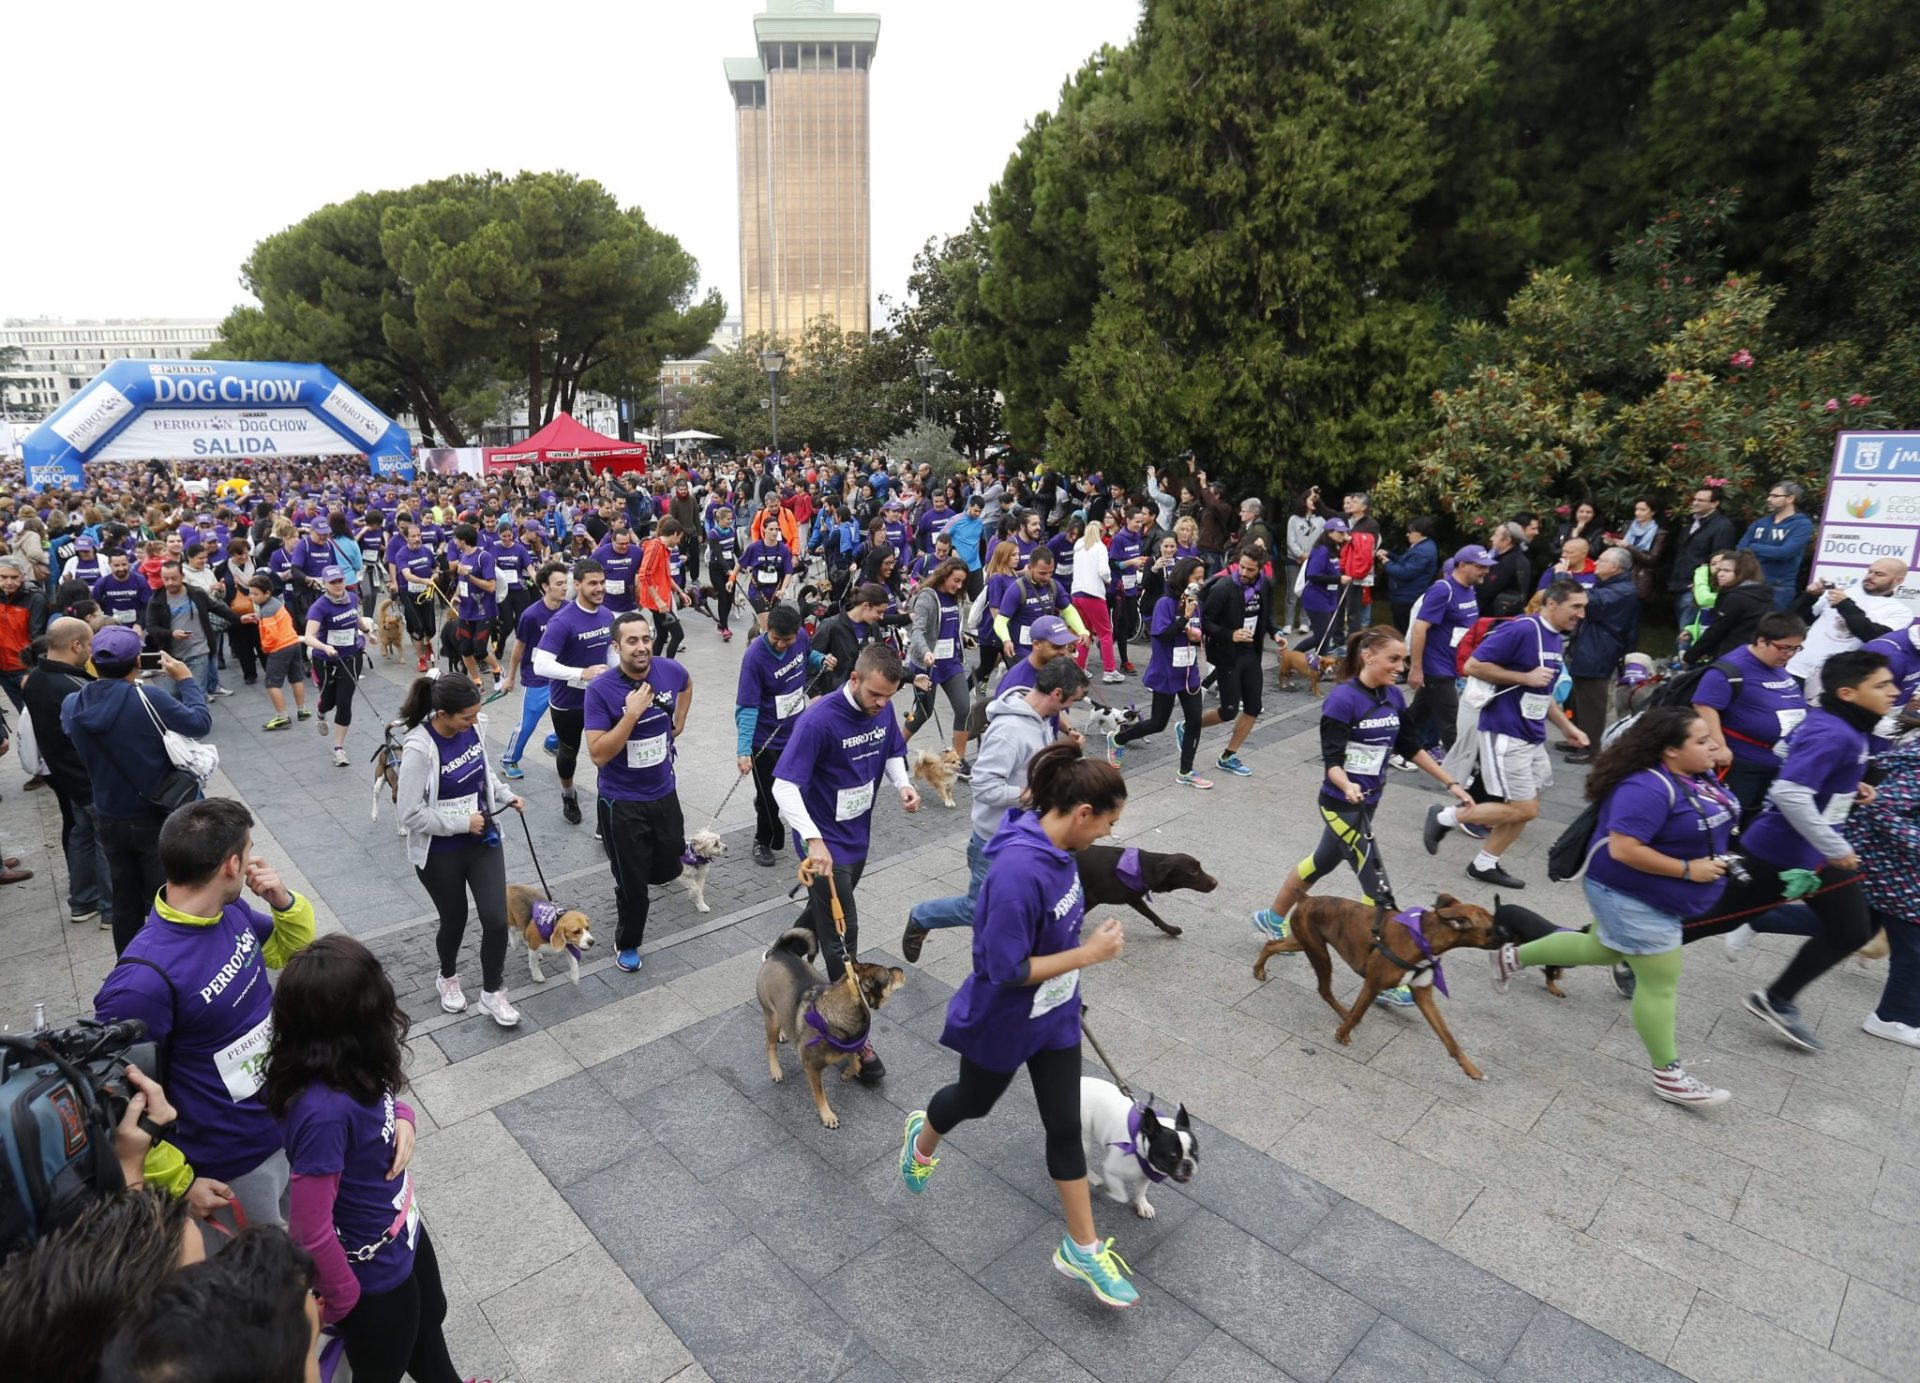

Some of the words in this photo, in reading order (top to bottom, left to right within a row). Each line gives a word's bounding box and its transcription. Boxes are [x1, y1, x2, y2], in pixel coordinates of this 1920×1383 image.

[151, 375, 216, 402] DOG
[219, 375, 302, 402] CHOW
[239, 419, 267, 432] DOG
[269, 418, 308, 431] CHOW
[192, 437, 278, 454] SALIDA
[31, 474, 51, 483] DOG
[1824, 540, 1857, 554] DOG
[1858, 542, 1909, 557] CHOW
